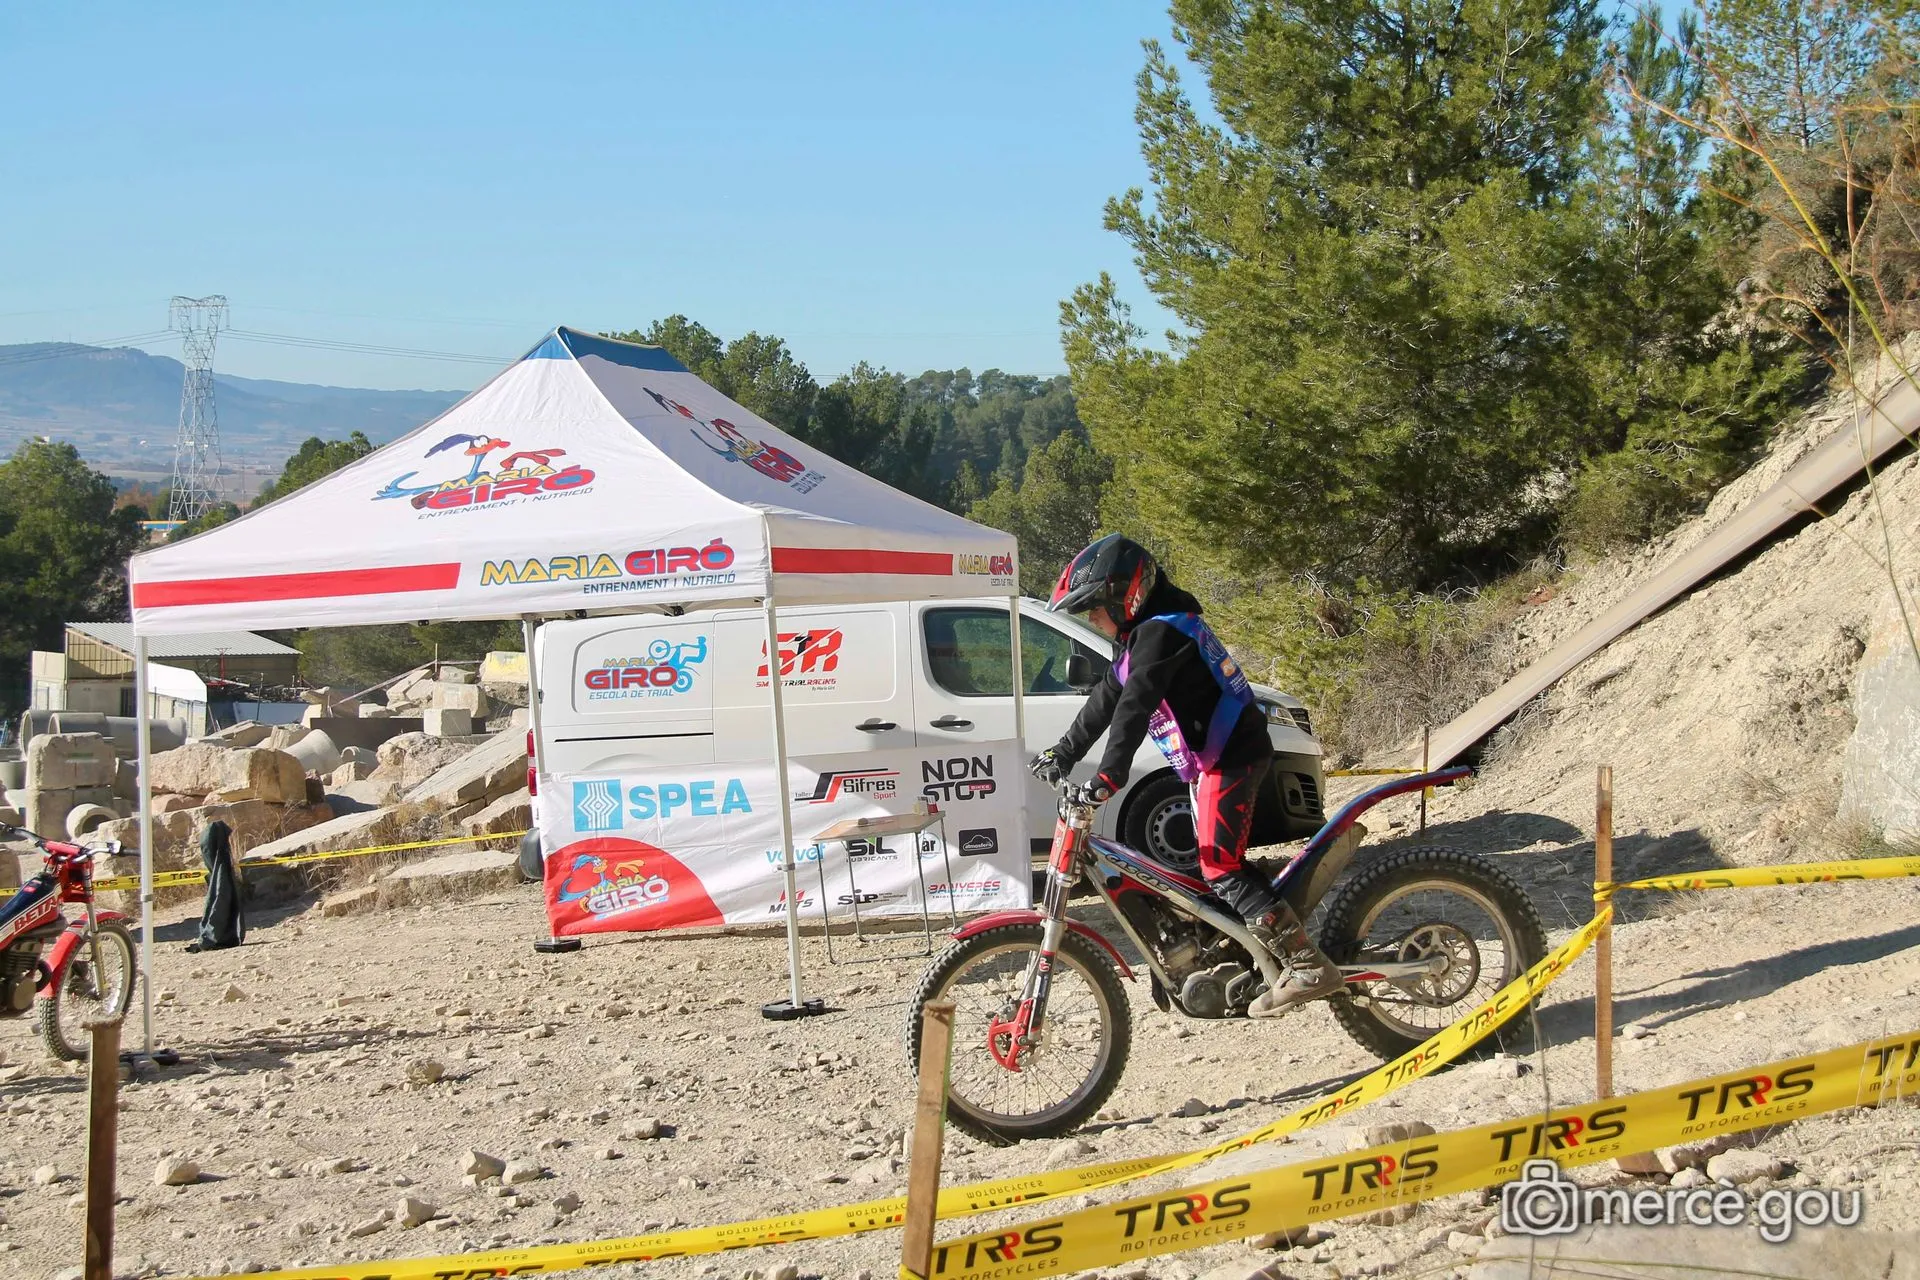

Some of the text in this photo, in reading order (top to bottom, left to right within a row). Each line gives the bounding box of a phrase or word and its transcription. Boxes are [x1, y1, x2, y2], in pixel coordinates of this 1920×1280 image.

[427, 465, 596, 510] GIRÓ
[437, 464, 556, 492] MARIA
[418, 499, 517, 520] ENTRENAMENT
[532, 487, 594, 503] NUTRICIÓ
[480, 537, 735, 587] MARIA GIRÓ
[959, 554, 990, 575] MARIA
[583, 578, 669, 595] ENTRENAMENT
[682, 570, 735, 587] NUTRICIÓ
[584, 662, 678, 690] GIRÓ
[603, 657, 657, 668] MARIA
[589, 688, 675, 700] ESCOLA DE TRIAL
[921, 754, 994, 783] NON
[628, 778, 753, 820] SPEA
[843, 778, 896, 793] Sifres
[873, 791, 897, 801] Sport
[922, 779, 997, 801] STOP
[588, 874, 670, 914] GIRÓ
[590, 874, 647, 896] MARIA
[1680, 1099, 1808, 1136] MOTORCYCLES
[1307, 1182, 1433, 1216] MOTORCYCLES
[1120, 1219, 1247, 1254] MOTORCYCLES
